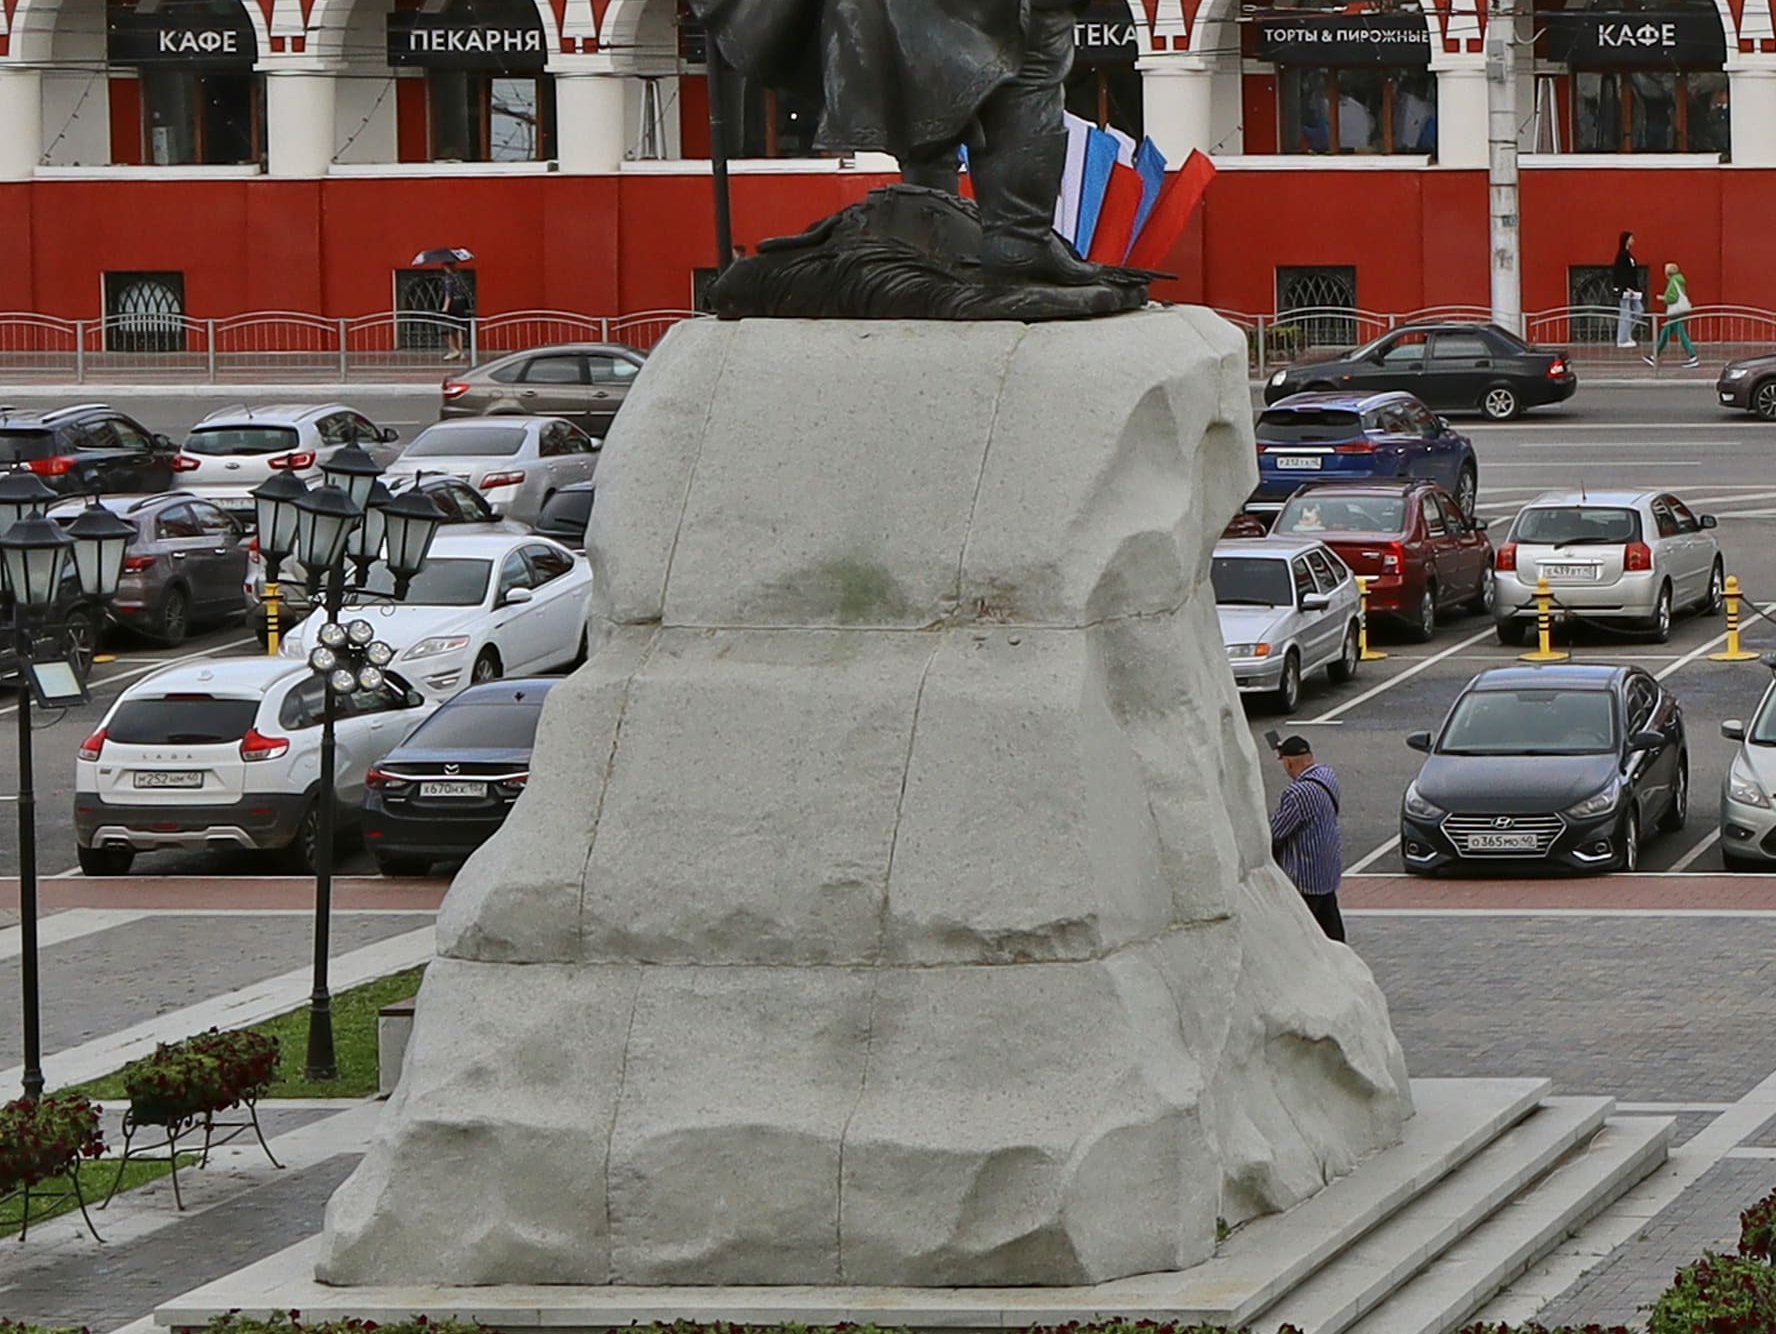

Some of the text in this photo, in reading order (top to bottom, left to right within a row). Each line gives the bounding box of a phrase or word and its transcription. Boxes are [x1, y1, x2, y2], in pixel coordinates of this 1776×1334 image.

[160, 30, 237, 52] КАФЕ
[410, 29, 541, 52] ПЕКАРНЯ
[1073, 23, 1137, 46] ТЕКА
[1264, 29, 1429, 43] ТОРТЫ & ПИРОЖНЫЕ
[1598, 23, 1677, 47] КАФЕ
